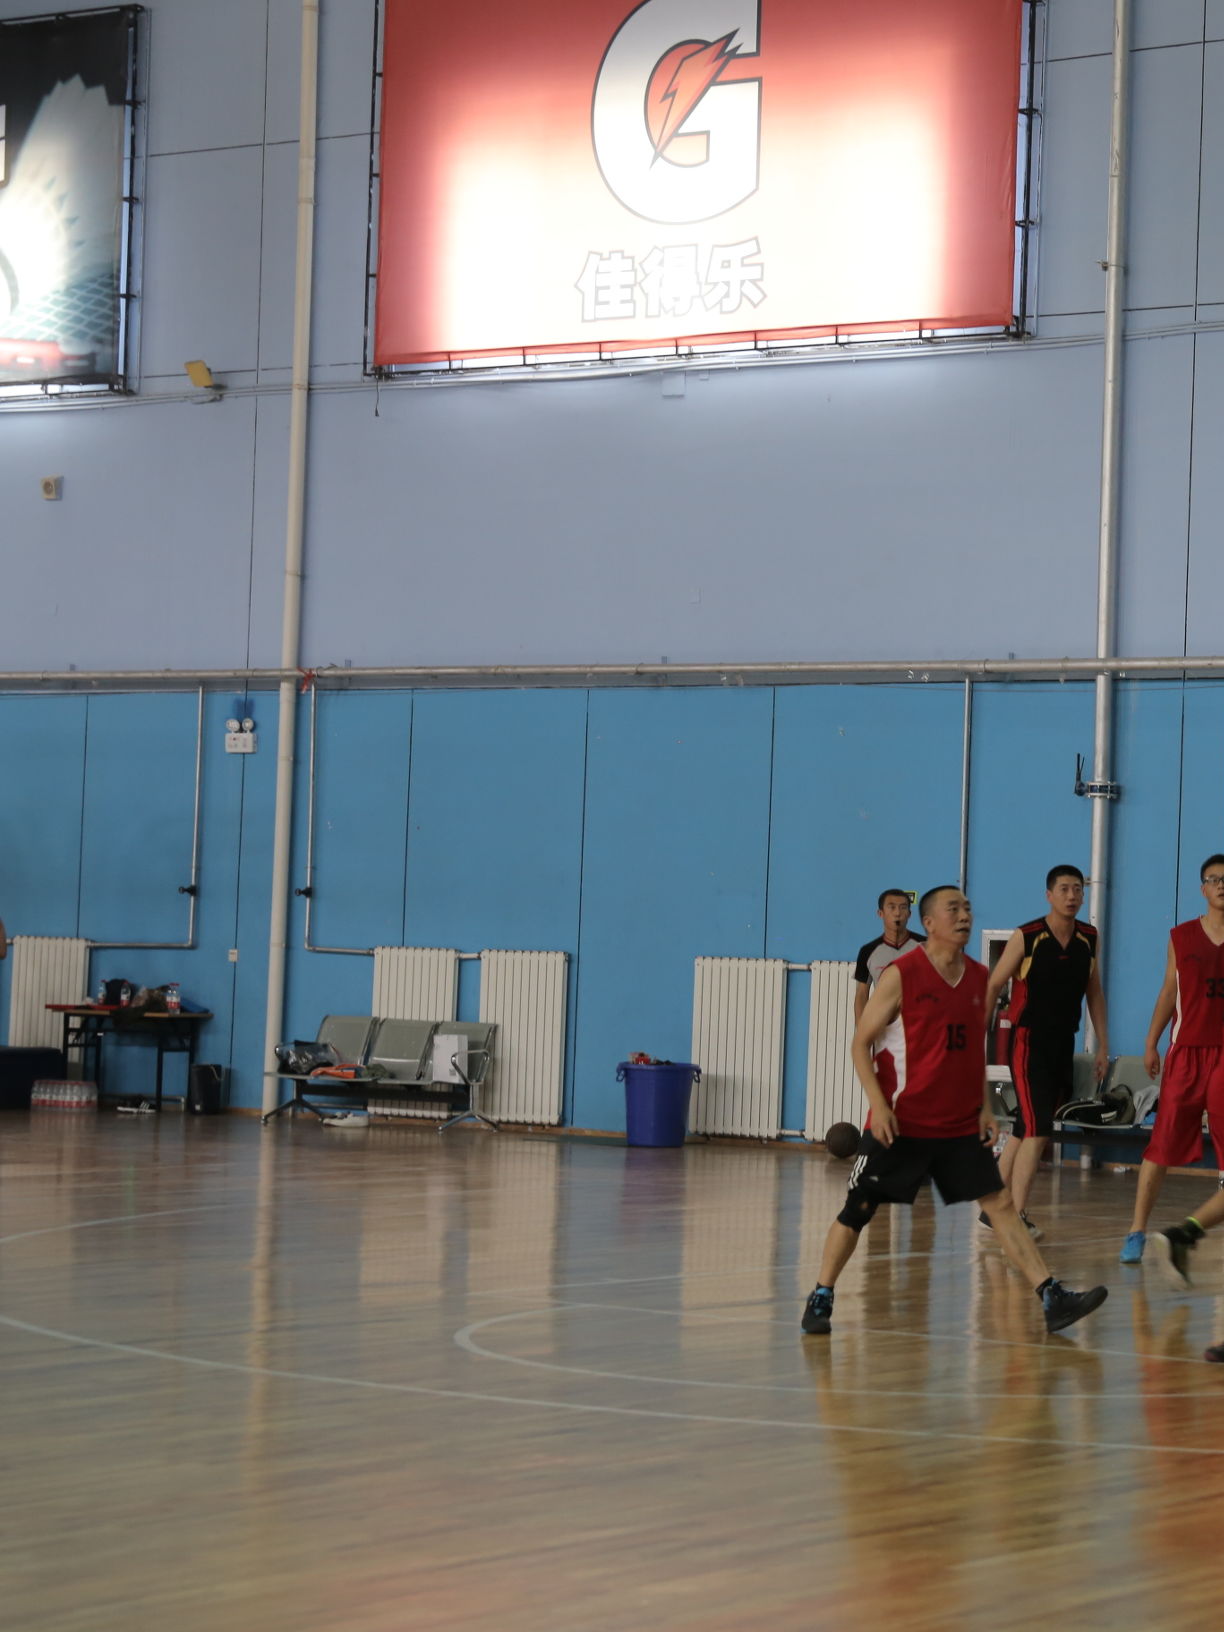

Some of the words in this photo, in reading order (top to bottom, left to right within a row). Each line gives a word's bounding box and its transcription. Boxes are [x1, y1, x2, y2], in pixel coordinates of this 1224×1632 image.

[574, 236, 768, 323] 佳得乐
[945, 1023, 968, 1051] 15
